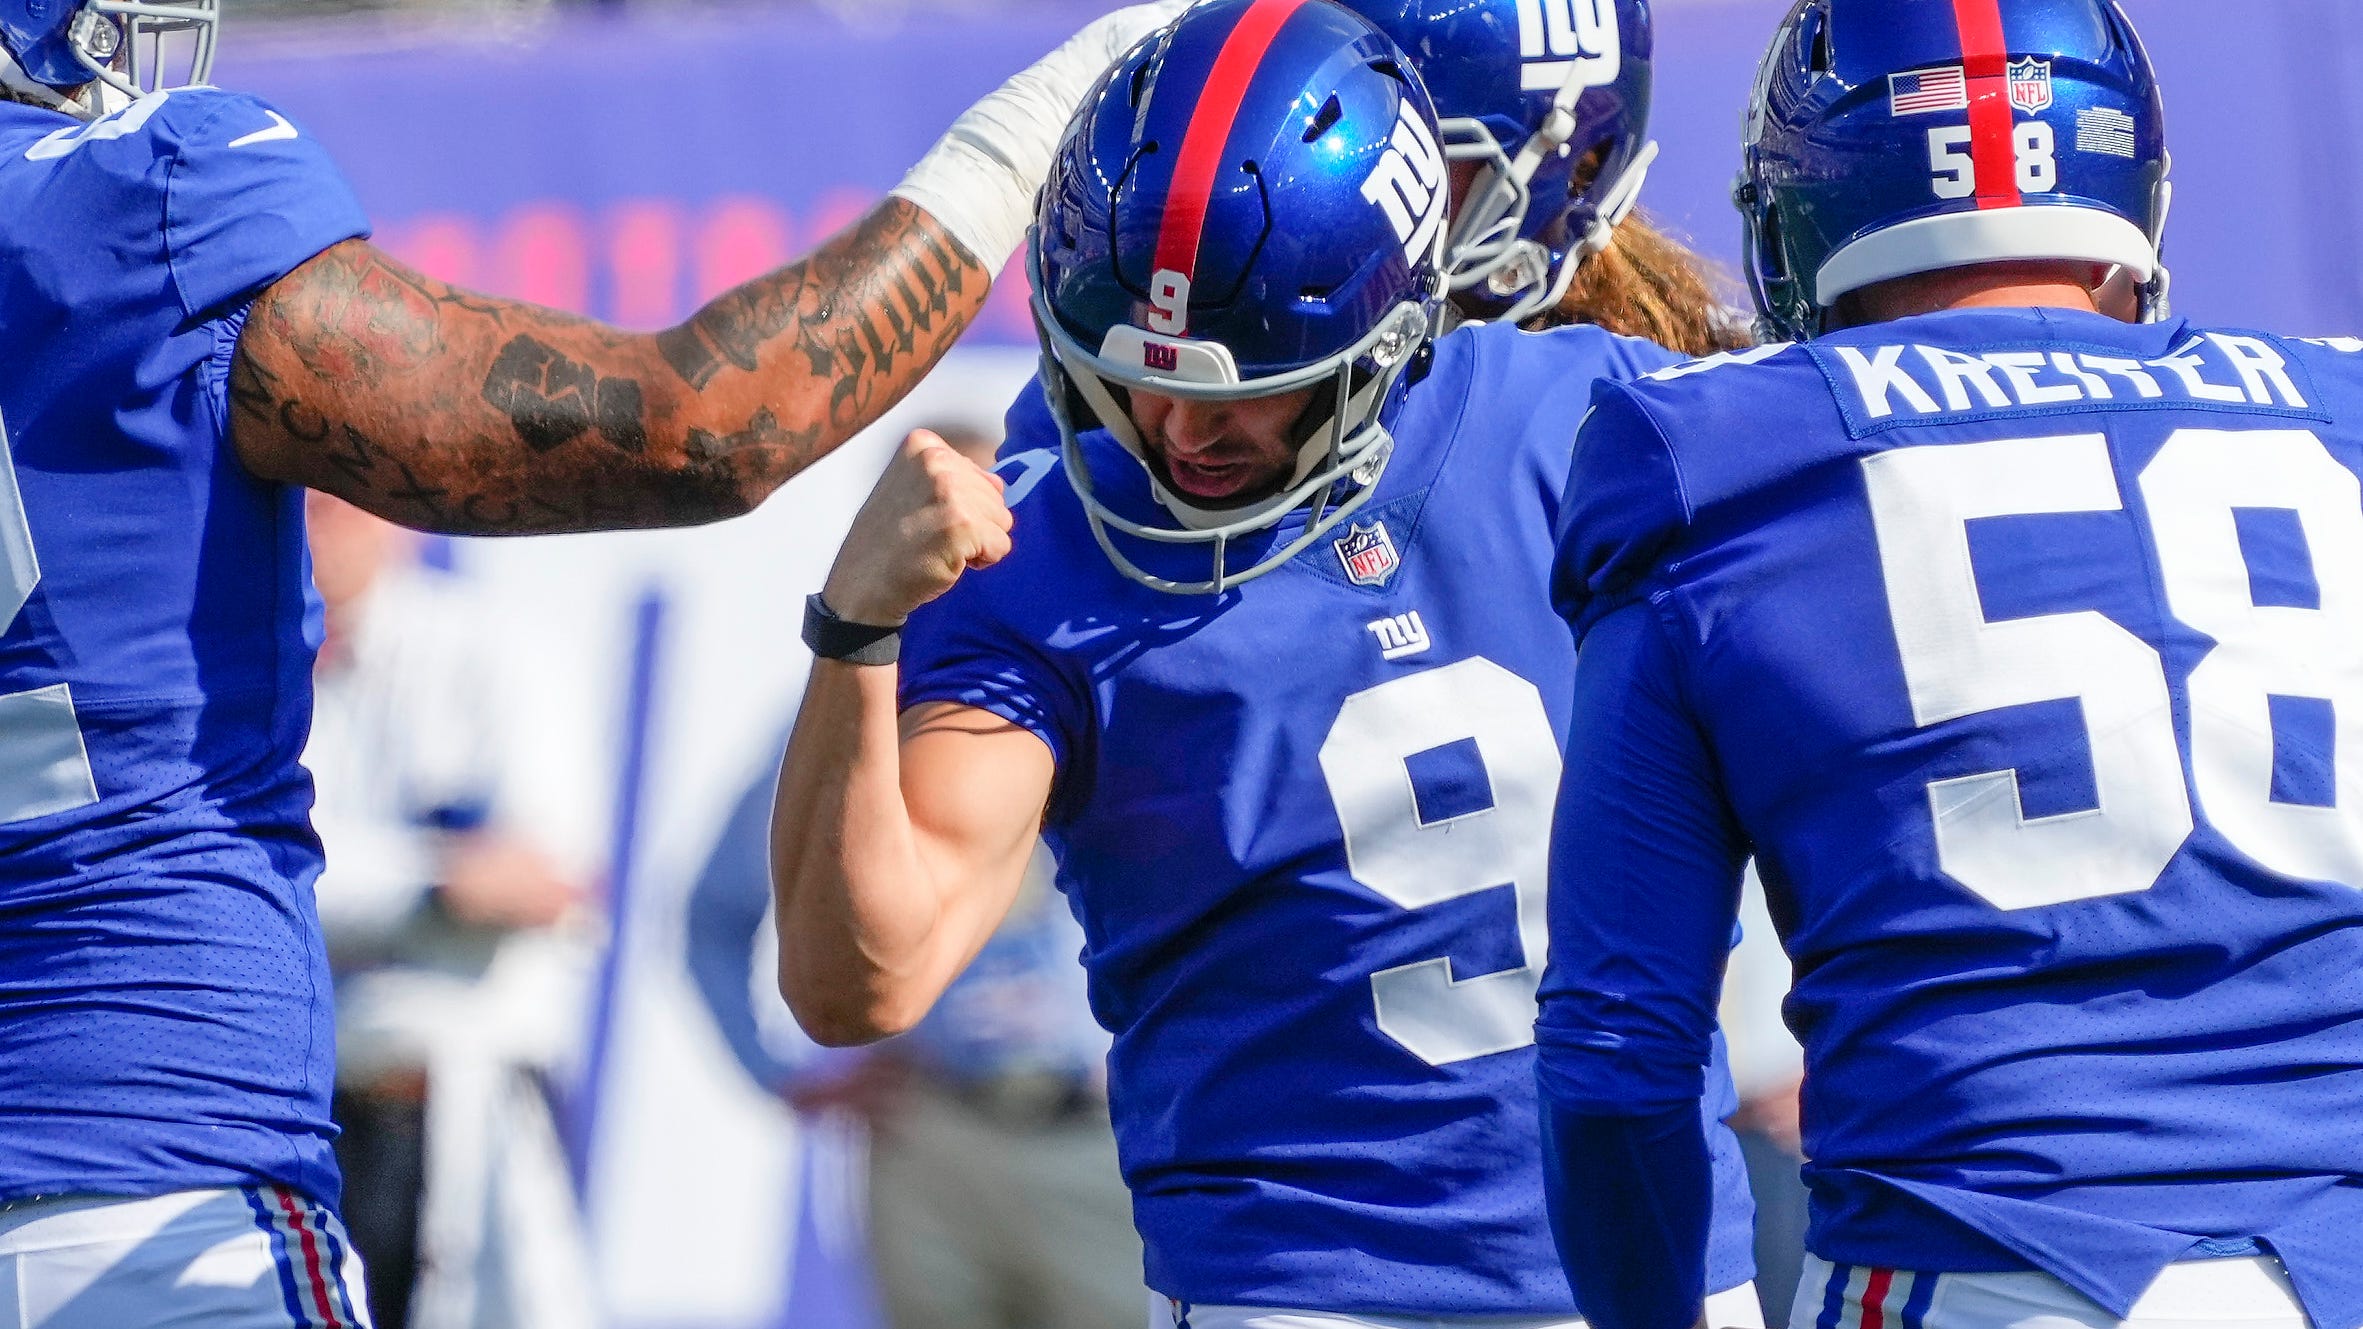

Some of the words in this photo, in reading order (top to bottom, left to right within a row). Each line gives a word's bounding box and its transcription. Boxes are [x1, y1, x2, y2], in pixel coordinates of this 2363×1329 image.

[2014, 81, 2047, 103] NFL
[1928, 120, 2057, 200] 58
[1148, 268, 1191, 336] 9
[1834, 333, 2310, 419] KREITER
[1351, 547, 1390, 577] NFL
[1860, 428, 2363, 911] 58
[1318, 655, 1563, 1066] 9
